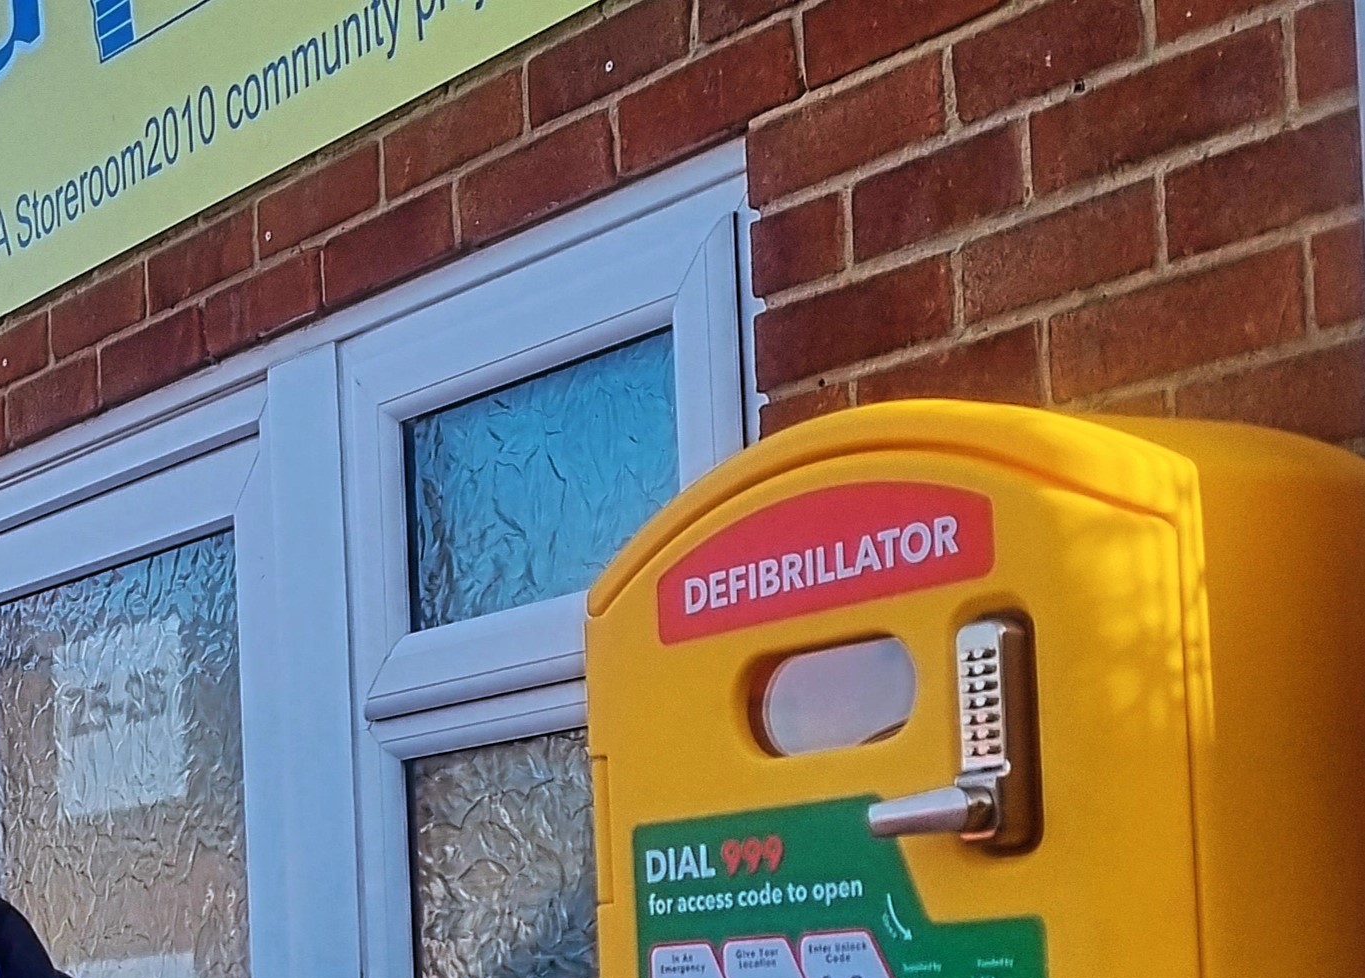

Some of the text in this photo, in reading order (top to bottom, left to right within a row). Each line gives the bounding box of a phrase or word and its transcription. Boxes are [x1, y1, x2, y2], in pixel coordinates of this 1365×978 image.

[226, 0, 400, 129] community
[684, 515, 959, 615] DEFIBRILLATOR
[646, 835, 784, 884] DIAL 999
[648, 878, 863, 916] for access code to open
[736, 948, 778, 960] Give Your
[808, 941, 867, 954] Enter Unlock
[739, 959, 777, 969] Location
[825, 954, 851, 963] Code
[660, 964, 705, 975] Emergency
